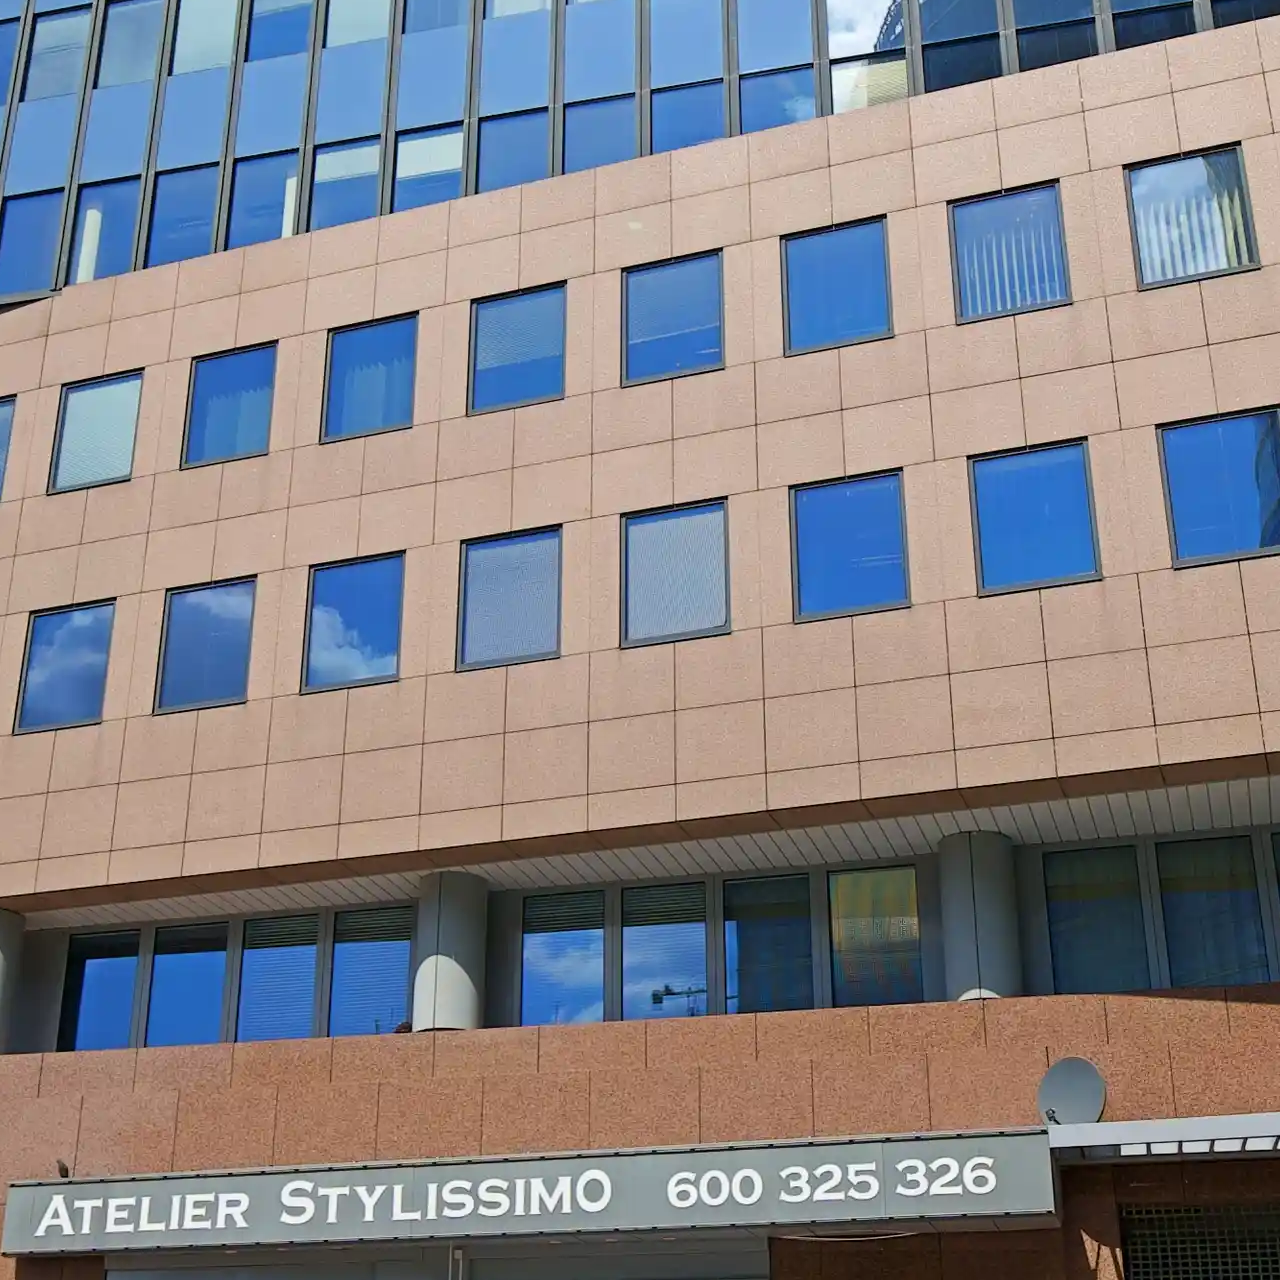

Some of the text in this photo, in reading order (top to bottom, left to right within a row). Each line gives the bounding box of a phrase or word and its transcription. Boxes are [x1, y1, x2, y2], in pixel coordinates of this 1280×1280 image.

[33, 1156, 998, 1237] ATELIER STYLISSIMO 600 325 326
